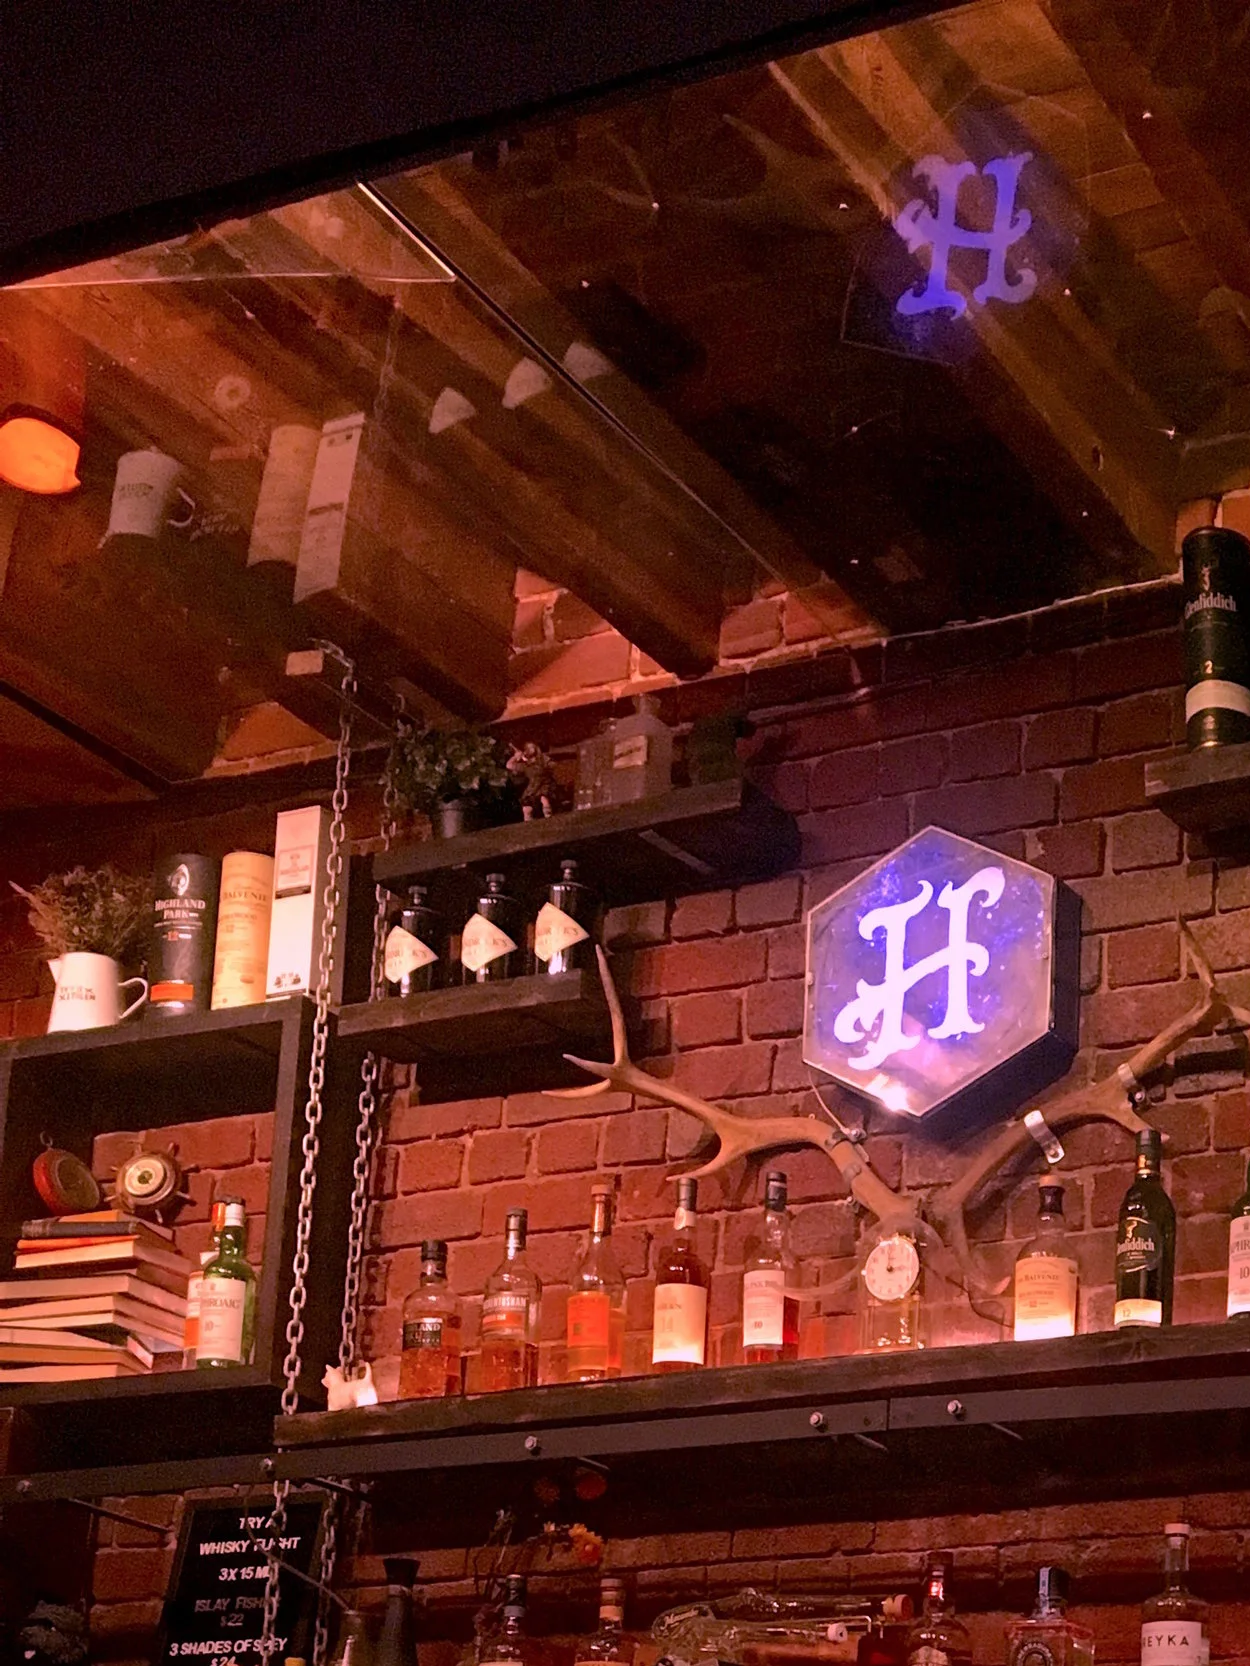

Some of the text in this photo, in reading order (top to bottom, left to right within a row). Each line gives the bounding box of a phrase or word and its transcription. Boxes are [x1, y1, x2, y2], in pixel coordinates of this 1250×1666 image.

[155, 899, 206, 911] HIGHLAND
[163, 909, 190, 920] PARK
[834, 864, 1005, 1072] H
[1239, 1266, 1250, 1279] 10
[239, 1516, 266, 1529] TRY
[200, 1540, 250, 1555] WHISKY
[218, 1565, 270, 1581] 3X 15 ML
[194, 1598, 231, 1612] ISLAY
[169, 1642, 179, 1656] 3
[180, 1640, 233, 1655] SHADES
[233, 1638, 253, 1653] OF
